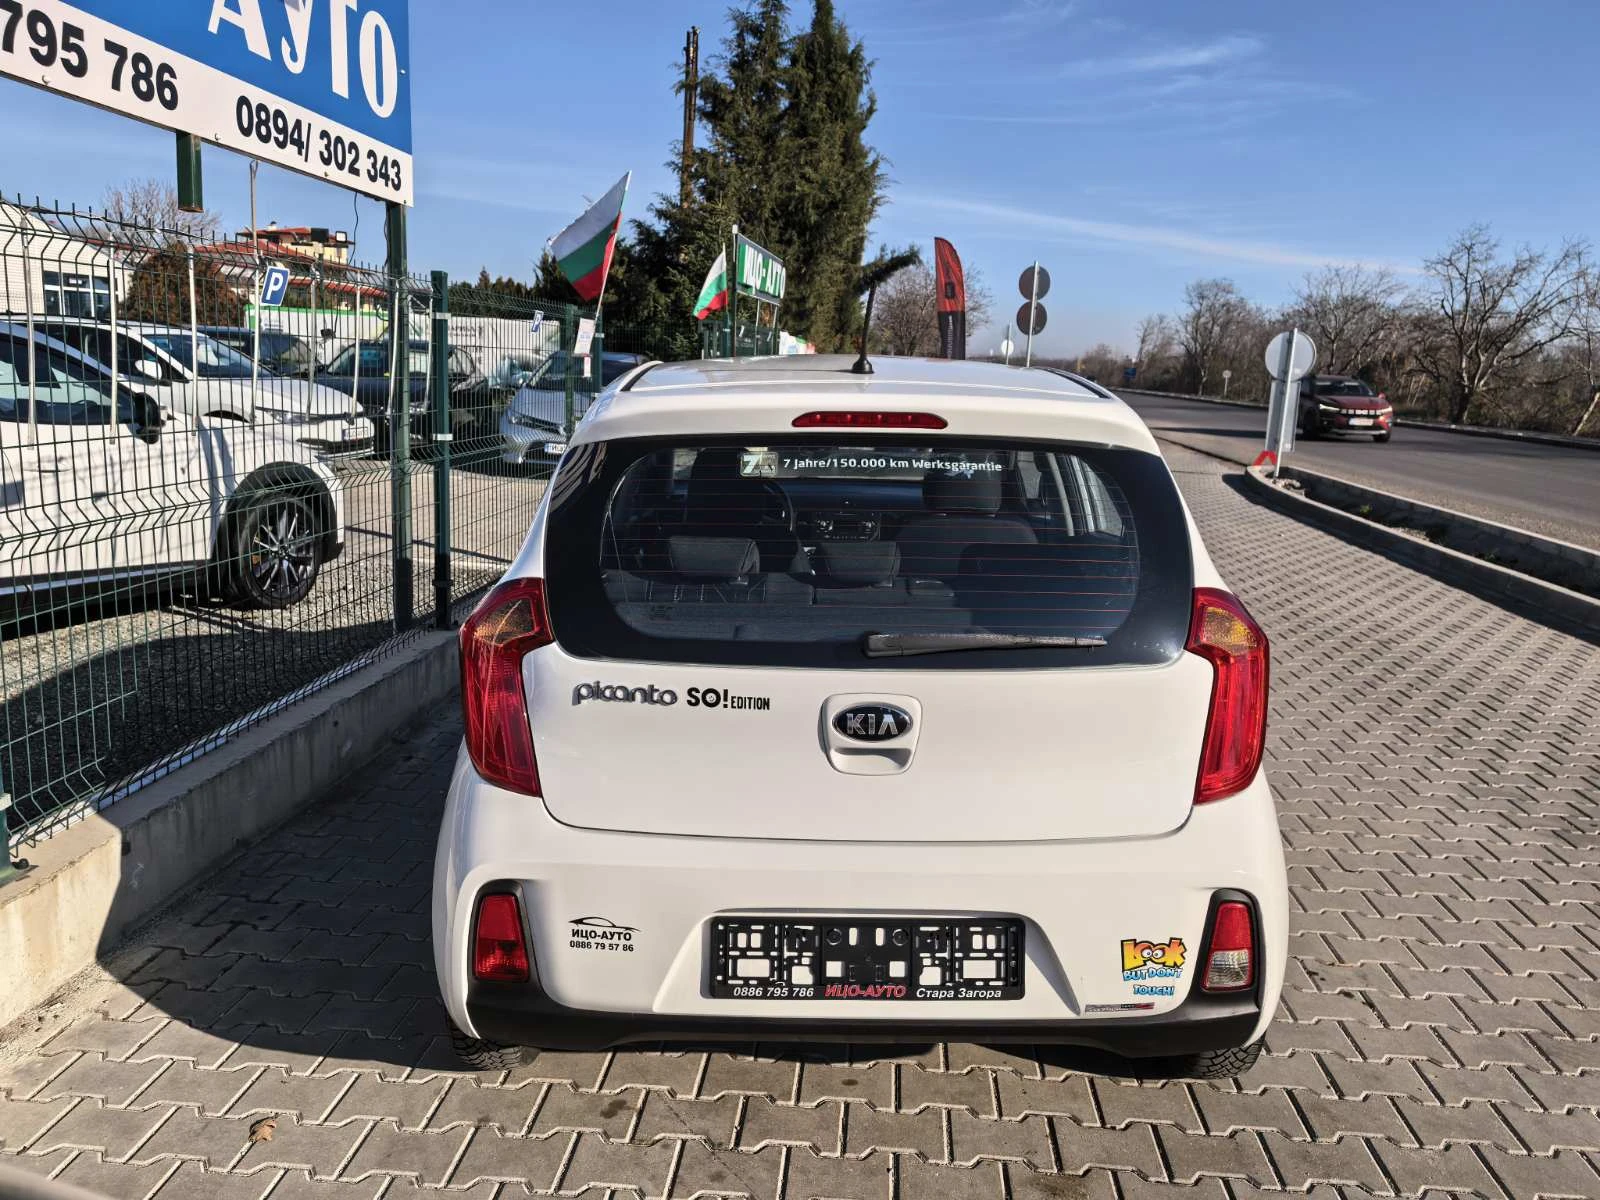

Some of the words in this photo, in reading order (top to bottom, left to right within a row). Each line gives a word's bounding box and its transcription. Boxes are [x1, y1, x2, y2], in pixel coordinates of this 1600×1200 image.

[0, 3, 89, 78] 795
[103, 38, 179, 111] 786
[235, 94, 312, 163] 0894/
[318, 130, 361, 178] 302
[366, 149, 402, 192] 343
[265, 271, 284, 301] P
[783, 458, 790, 468] 7
[793, 457, 887, 470] Jahre/150.000
[889, 458, 909, 469] km
[912, 458, 1003, 473] Werksgarantie
[571, 680, 679, 707] picanto
[686, 687, 729, 709] SO!
[730, 695, 771, 711] EDITION
[845, 712, 899, 737] KIA
[571, 928, 632, 942] ИЦО-АУТО
[569, 940, 592, 950] 0886
[594, 942, 606, 950] 79
[608, 943, 620, 951] 57
[622, 944, 634, 952] 86
[1122, 969, 1148, 981] BUT
[1147, 966, 1184, 979] DON'T
[733, 986, 763, 997] 0886
[766, 986, 789, 997] 795
[791, 986, 815, 997] 786
[824, 984, 907, 998] ИЦО-АУТО
[916, 987, 955, 999] Стара
[957, 987, 1002, 999] Загора
